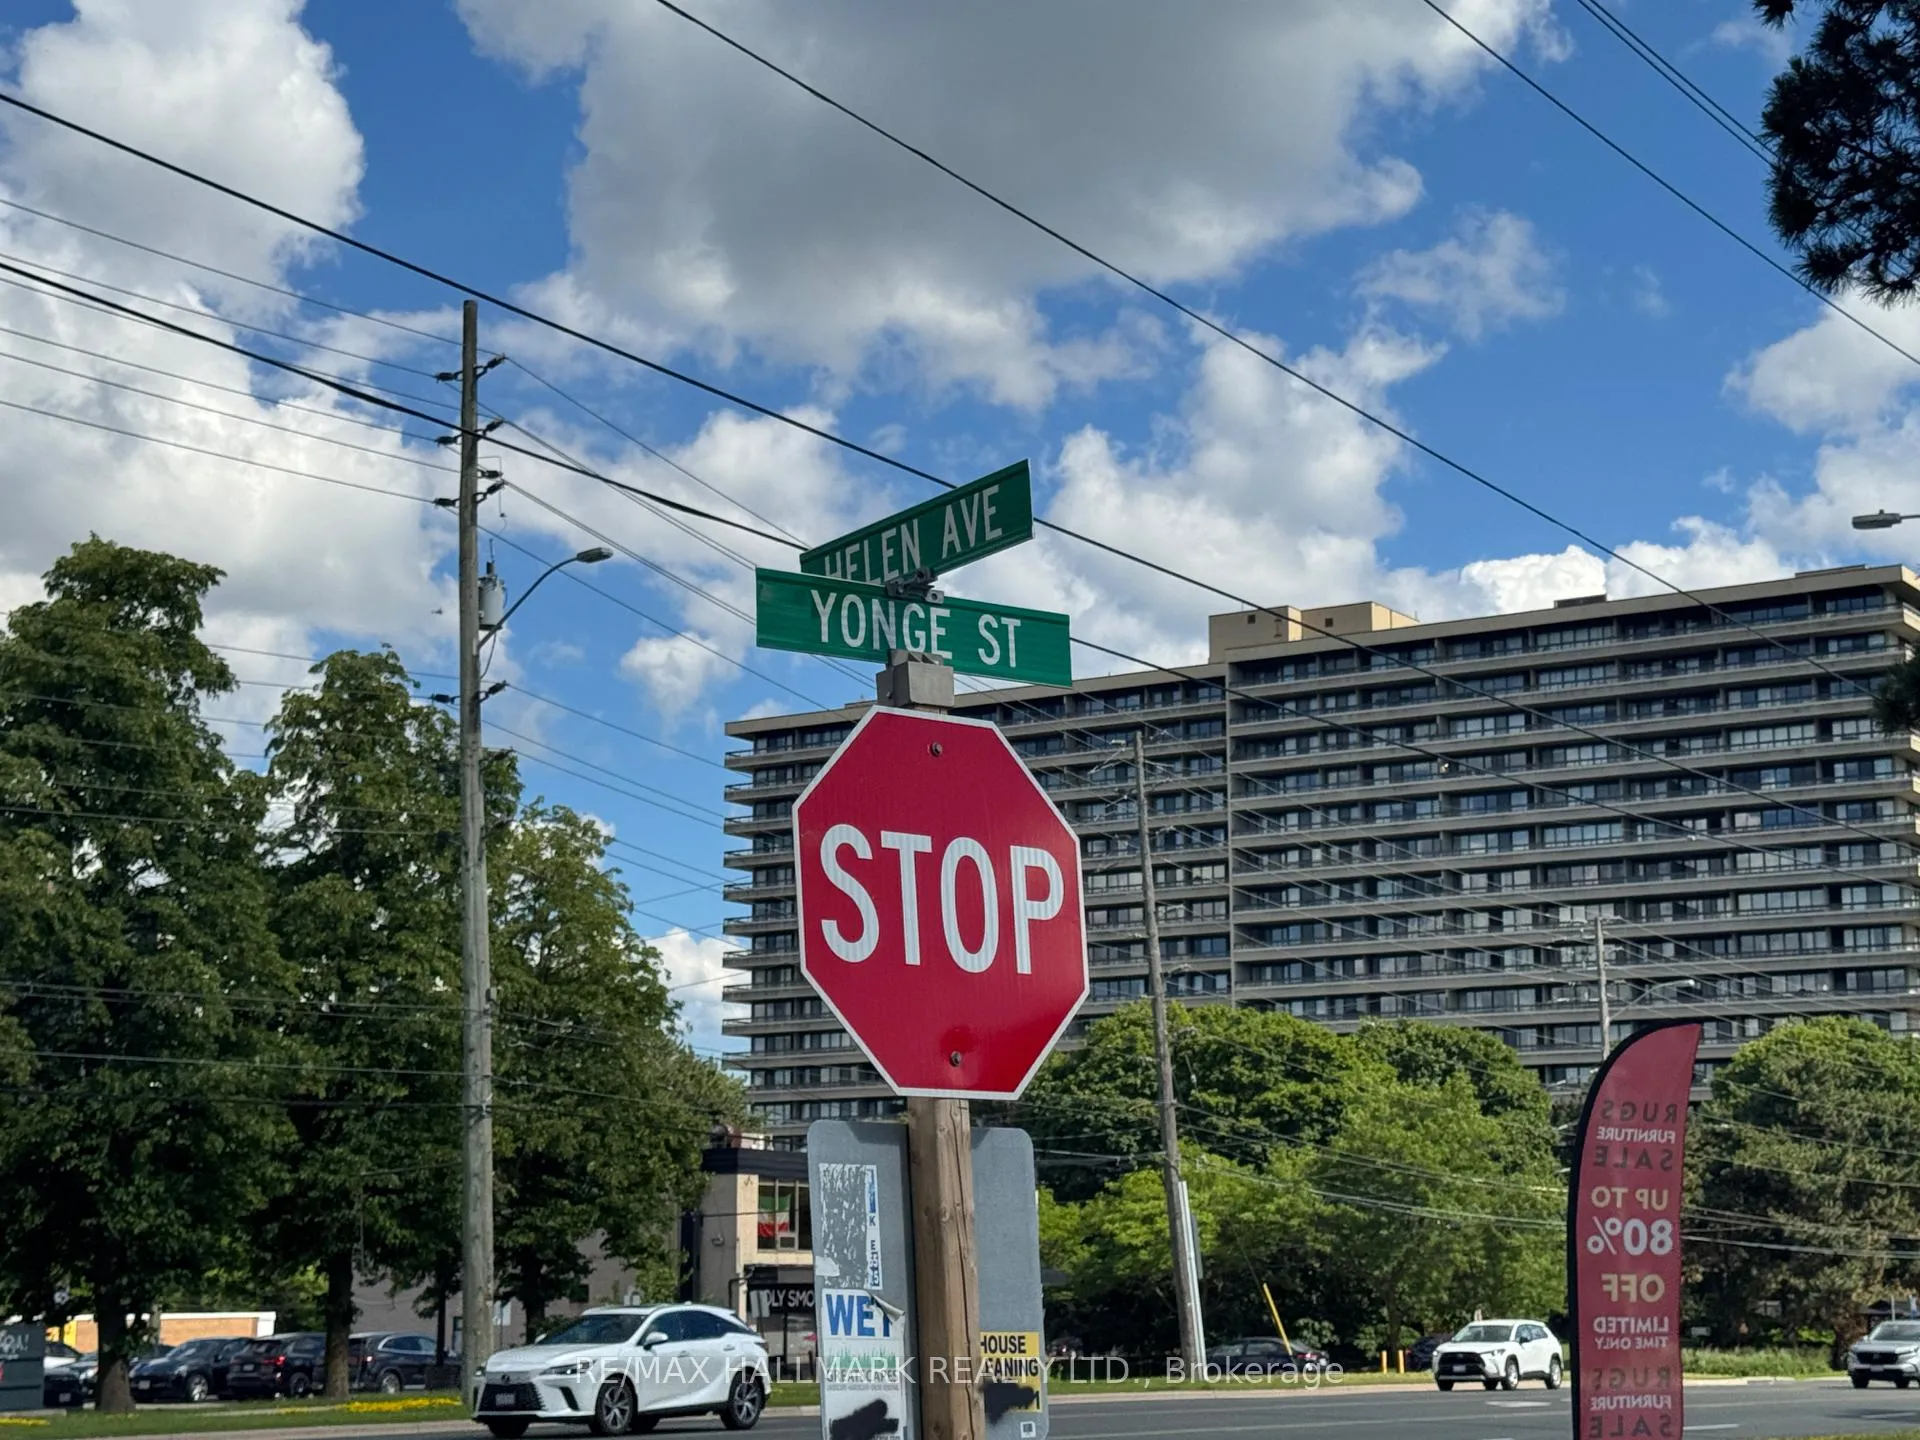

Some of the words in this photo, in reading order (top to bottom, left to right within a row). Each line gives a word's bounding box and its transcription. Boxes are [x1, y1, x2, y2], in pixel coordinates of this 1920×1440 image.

[824, 519, 921, 584] HELEN
[942, 484, 1002, 559] AVE
[811, 589, 952, 664] YONGE
[978, 613, 1021, 669] ST
[820, 824, 1064, 974] STOP
[981, 1335, 1026, 1354] HOUSE
